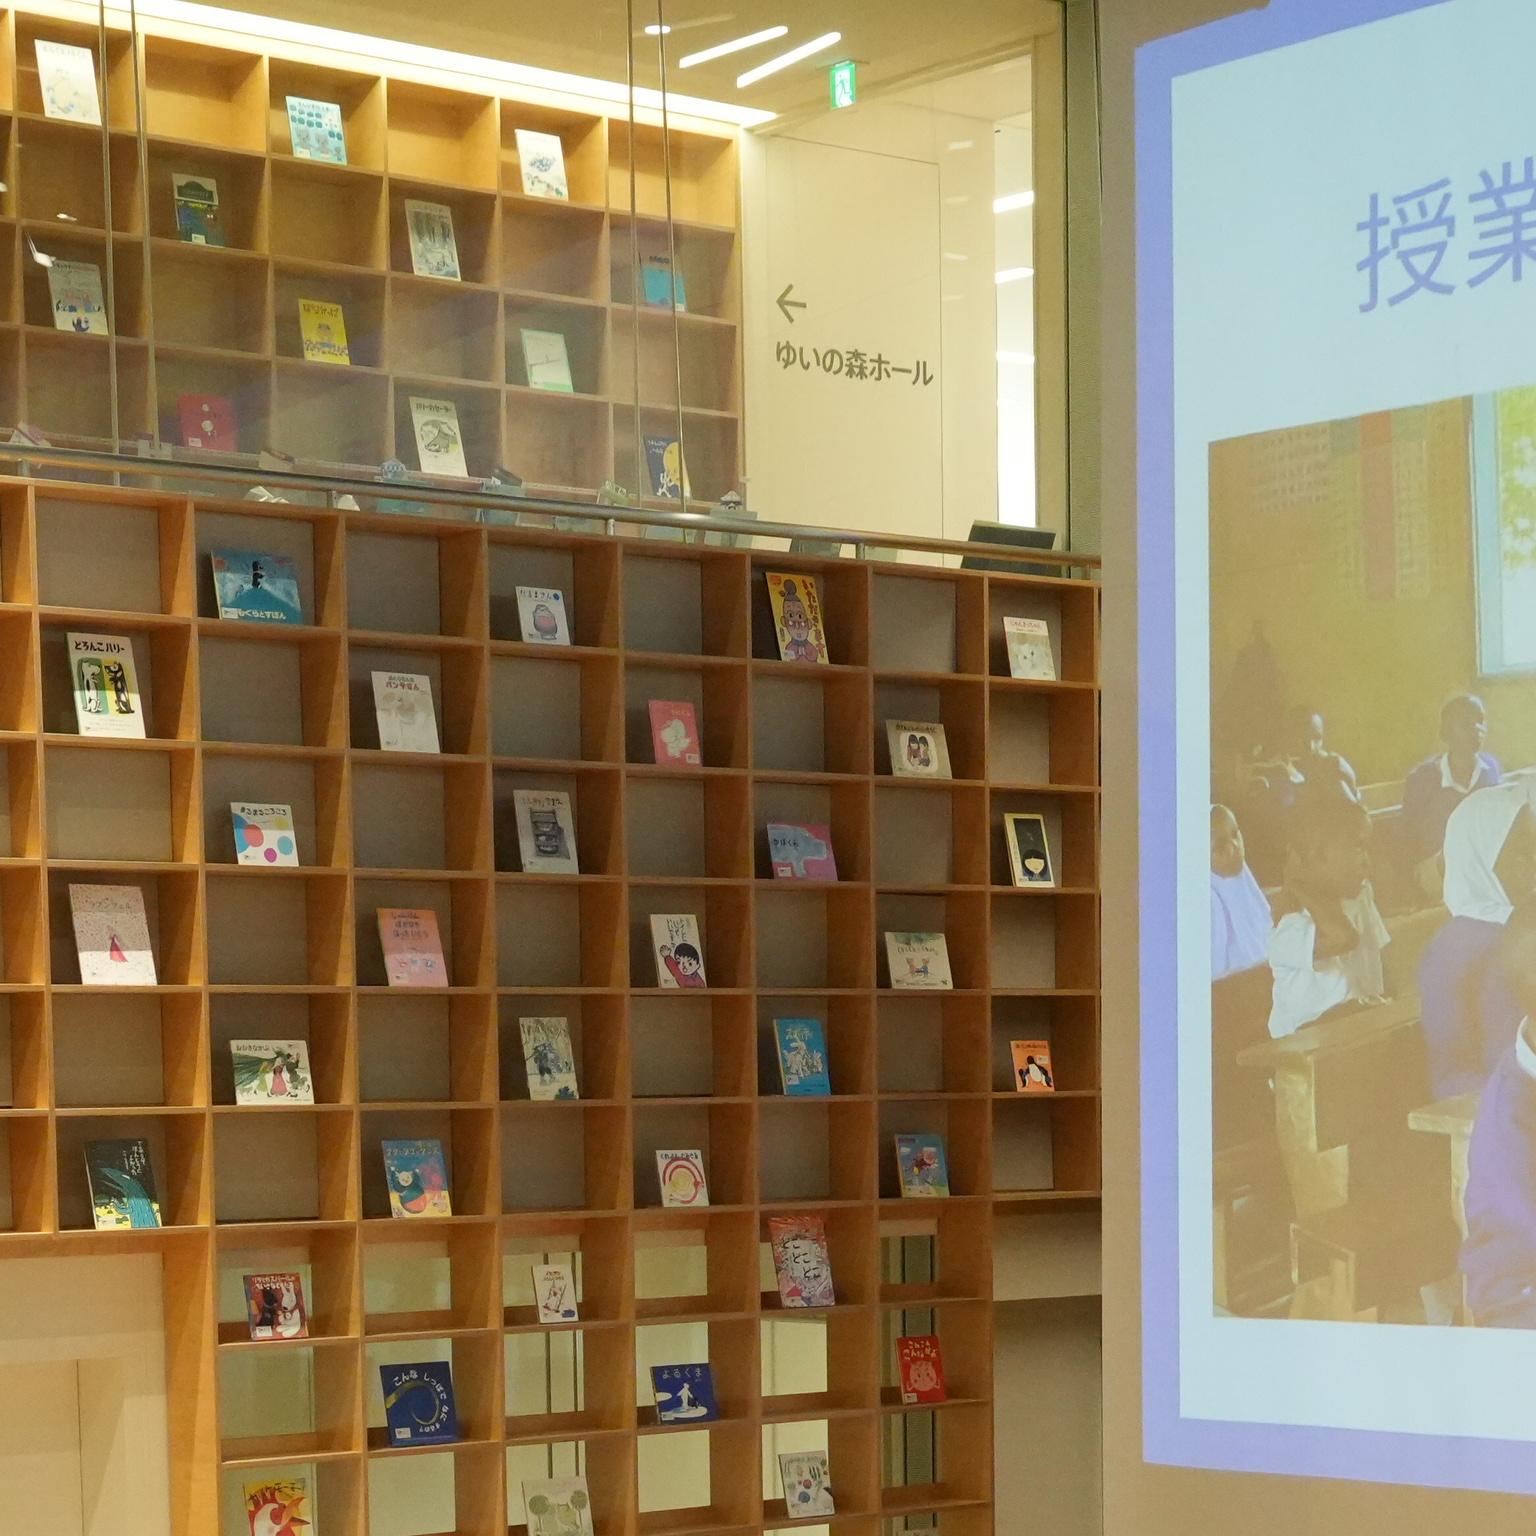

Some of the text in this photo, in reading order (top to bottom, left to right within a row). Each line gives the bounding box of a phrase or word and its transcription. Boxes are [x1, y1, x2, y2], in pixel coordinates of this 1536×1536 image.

[774, 341, 934, 388] ゆいの森ホール
[74, 640, 126, 654] どろんこハリー
[662, 1367, 703, 1379] よるくま
